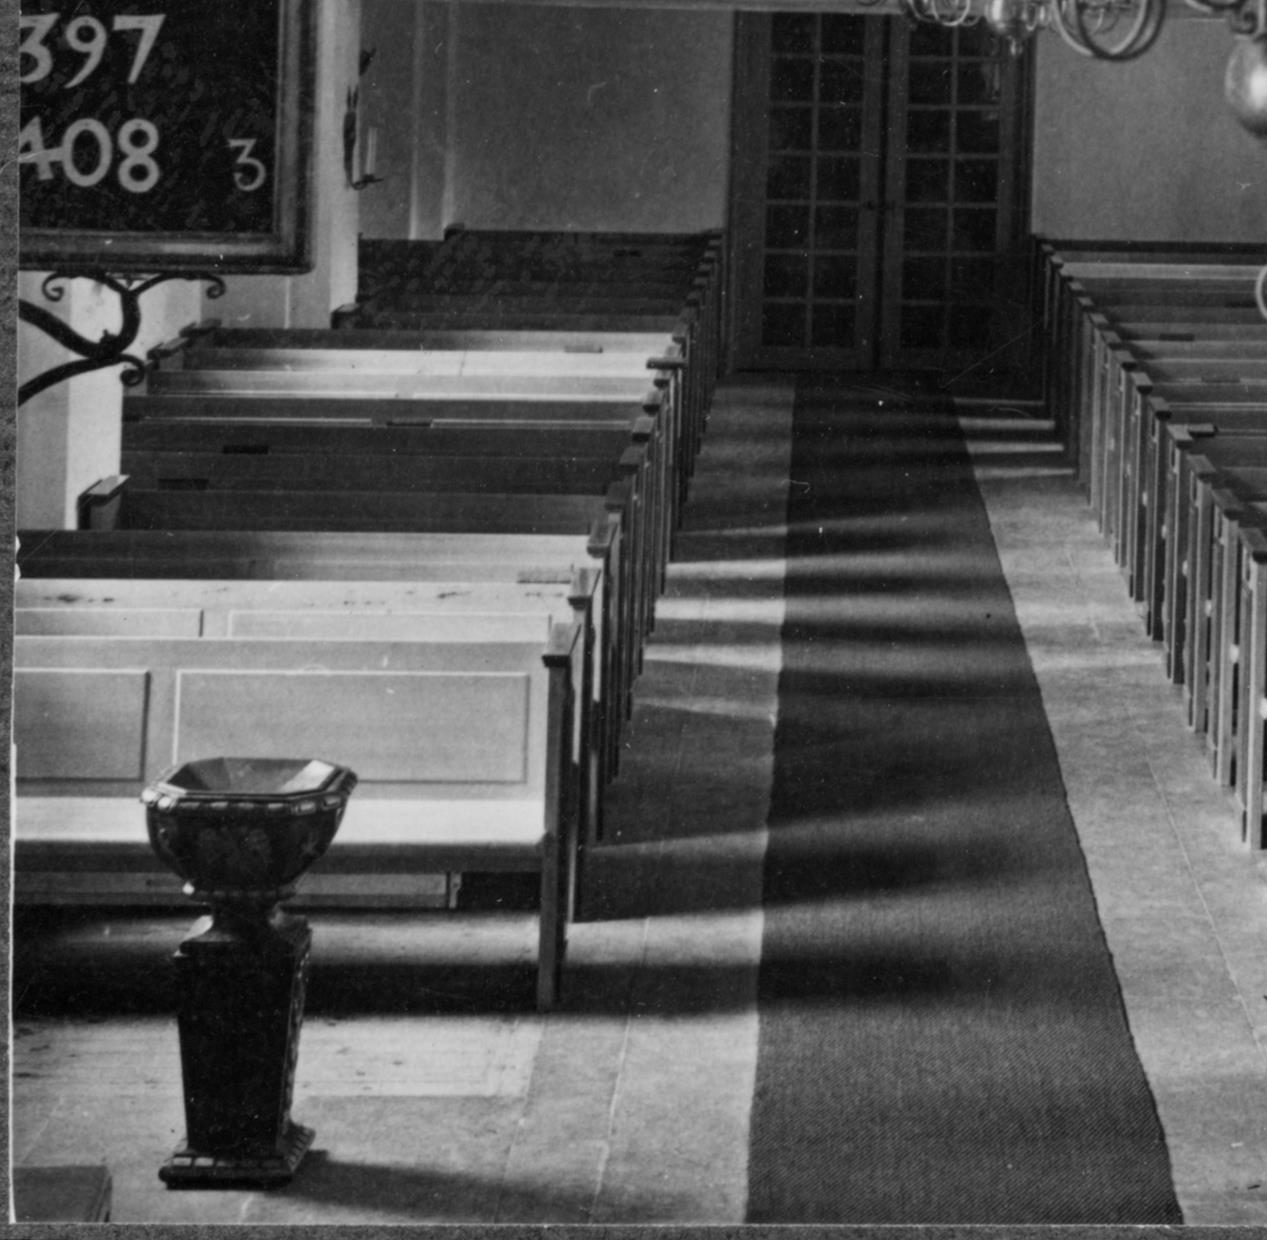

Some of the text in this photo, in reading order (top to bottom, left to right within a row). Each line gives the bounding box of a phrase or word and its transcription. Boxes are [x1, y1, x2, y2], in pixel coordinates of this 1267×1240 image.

[20, 13, 166, 88] 397
[19, 115, 266, 193] 408 3
